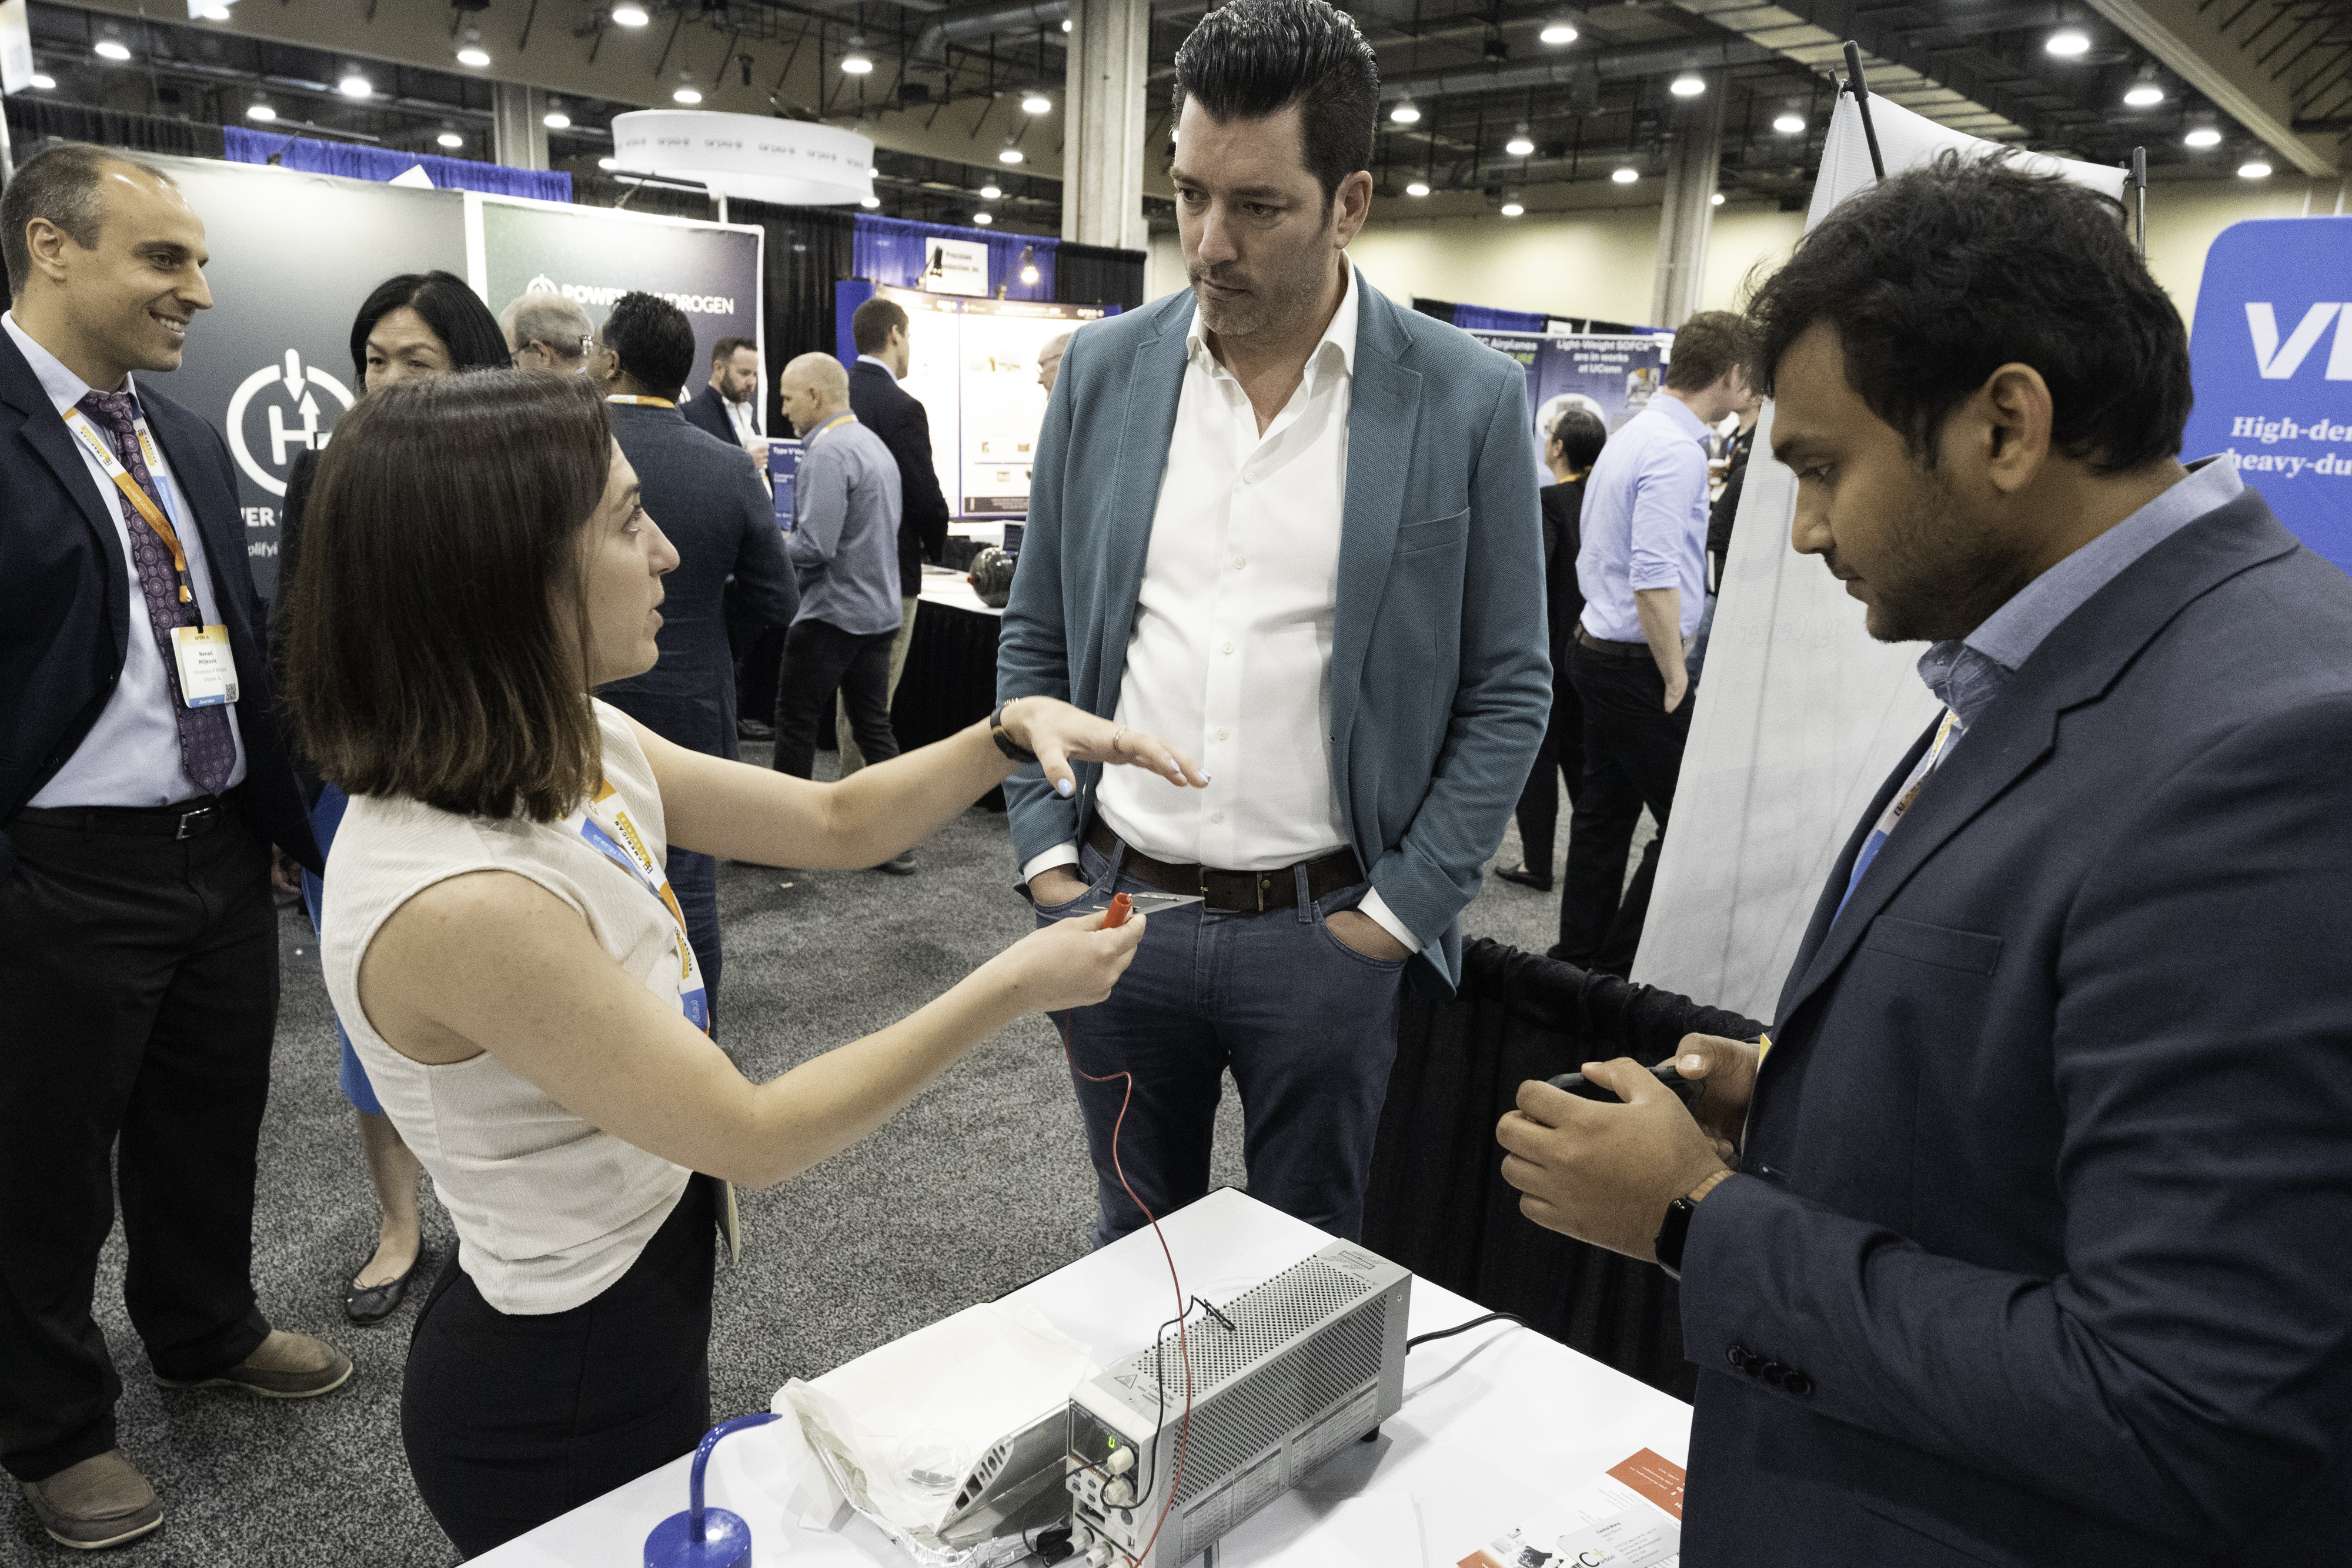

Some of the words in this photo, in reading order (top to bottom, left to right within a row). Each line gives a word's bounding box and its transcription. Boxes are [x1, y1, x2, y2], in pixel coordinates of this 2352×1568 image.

[654, 292, 734, 315] DROGEN
[614, 820, 643, 861] AMERICAN
[620, 816, 647, 860] ELEMENTS
[691, 999, 701, 1022] energy
